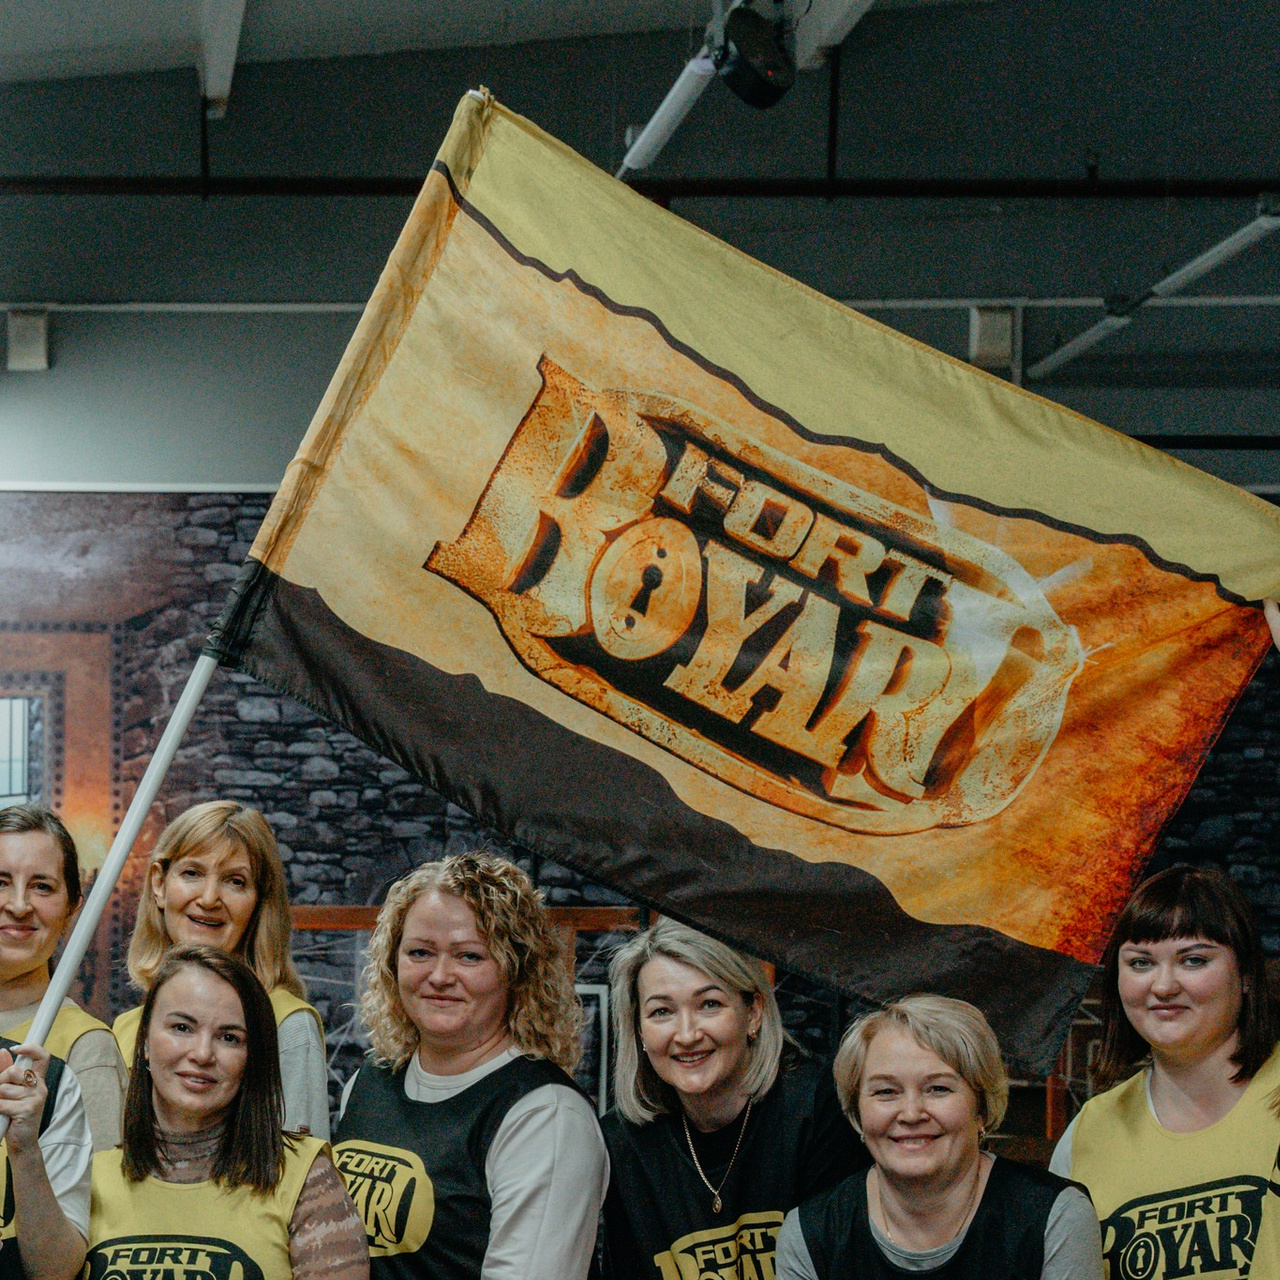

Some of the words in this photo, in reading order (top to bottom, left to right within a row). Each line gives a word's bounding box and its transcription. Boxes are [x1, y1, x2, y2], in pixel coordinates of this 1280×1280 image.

[658, 441, 955, 623] FORT
[422, 354, 1081, 829] BOYARD
[335, 1151, 399, 1178] FORT
[1136, 1191, 1236, 1230] FORT
[108, 1247, 208, 1266] FORT
[694, 1227, 768, 1269] FORT
